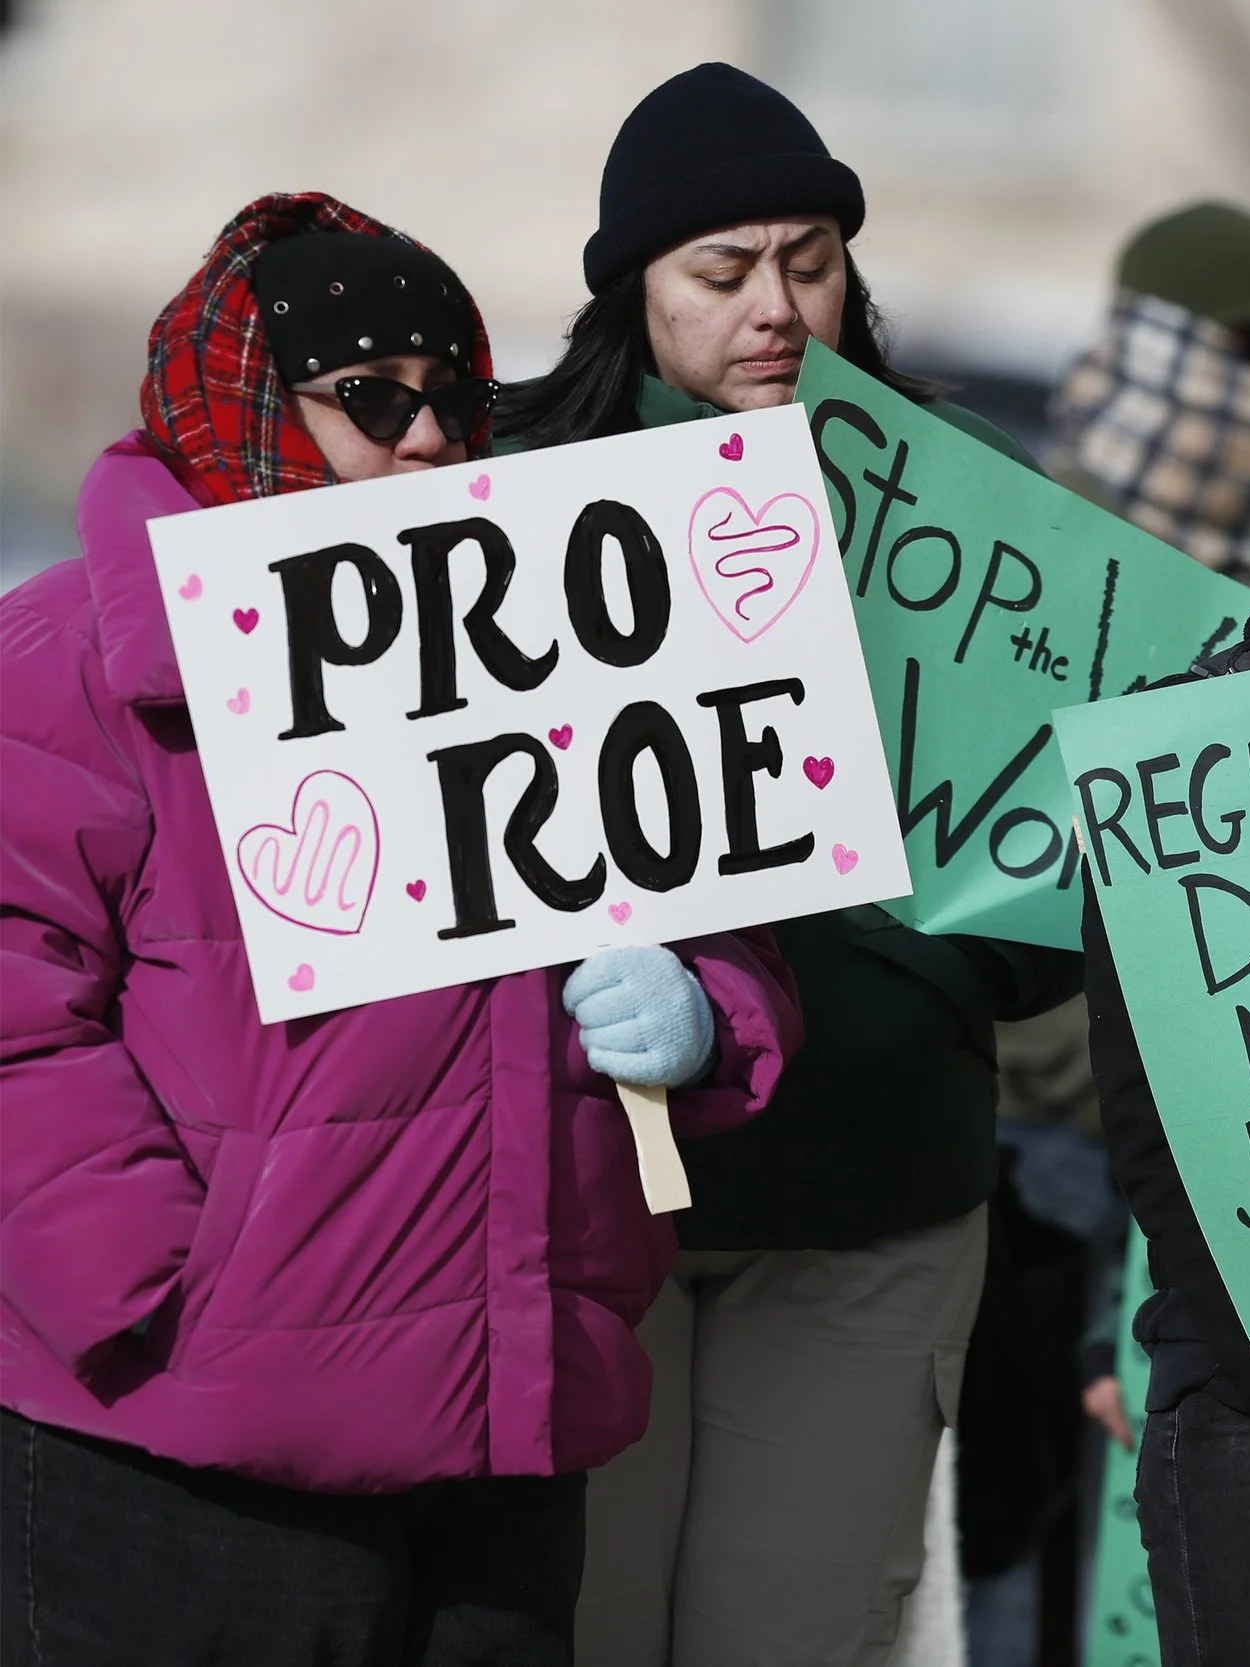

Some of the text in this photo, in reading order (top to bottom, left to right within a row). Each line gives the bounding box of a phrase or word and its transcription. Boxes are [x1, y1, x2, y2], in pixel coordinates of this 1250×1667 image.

[267, 499, 672, 741] PRO
[810, 398, 1043, 664] Stop
[1010, 627, 1070, 682] the
[426, 677, 816, 941] ROE
